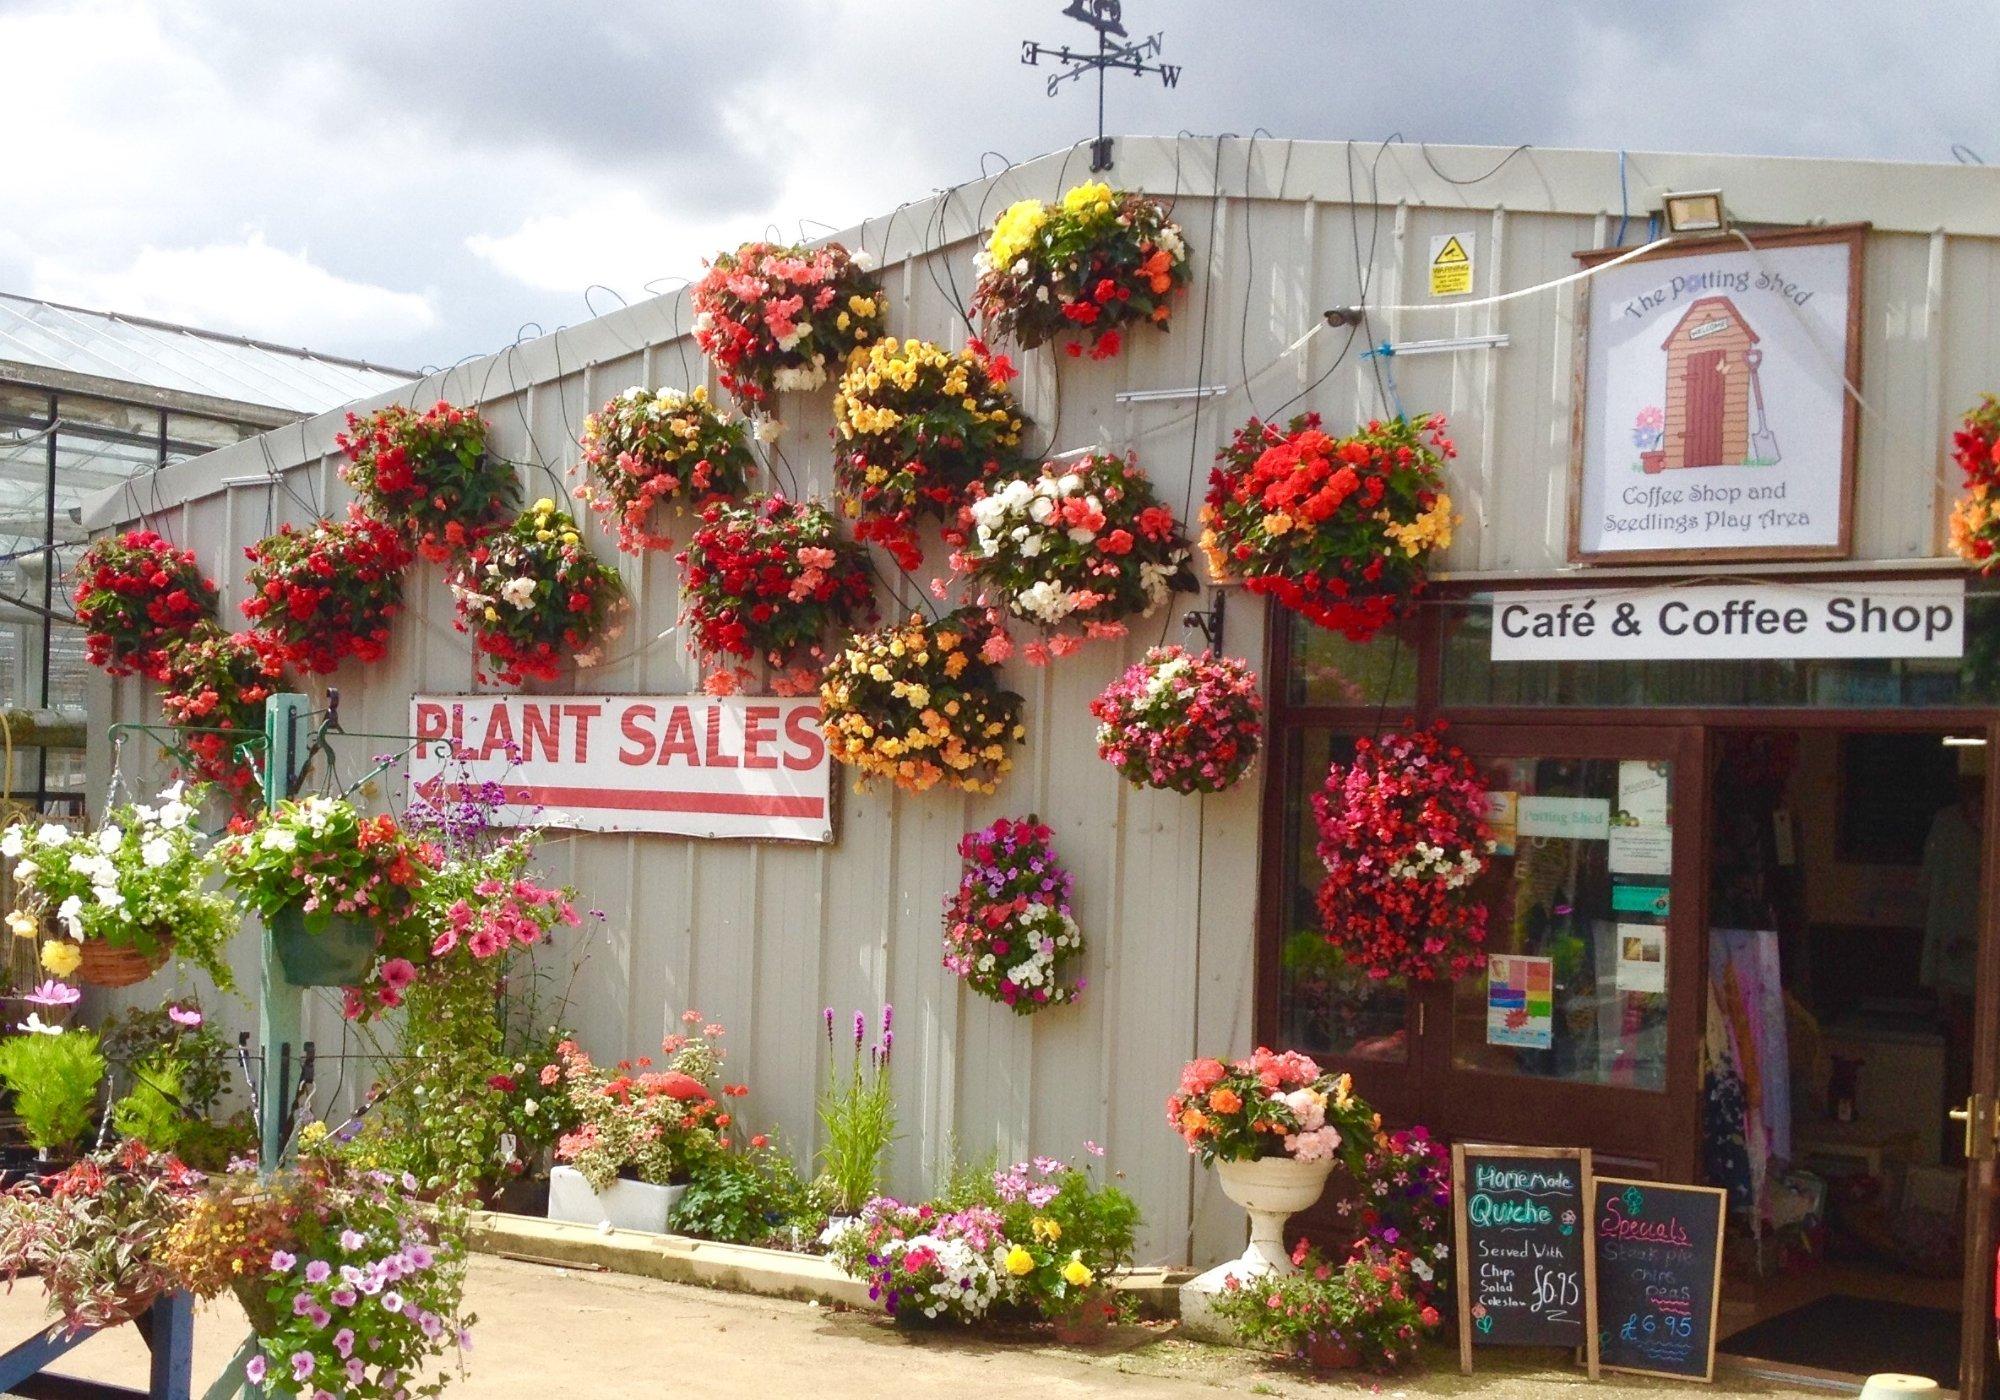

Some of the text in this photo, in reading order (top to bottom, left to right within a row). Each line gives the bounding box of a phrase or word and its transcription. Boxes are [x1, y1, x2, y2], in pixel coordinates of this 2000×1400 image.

[1159, 64, 1182, 89] W
[1625, 270, 1814, 319] The Potting Shed
[1622, 482, 1786, 507] Coffee Shop and
[1604, 509, 1810, 533] Seedlings Play Area
[1501, 598, 1953, 642] Café & Coffee Shop
[416, 703, 824, 770] PLANT SALES
[1470, 1194, 1552, 1227] Quiche
[1601, 1196, 1688, 1240] Specials
[1479, 1239, 1564, 1258] Served With
[1481, 1263, 1515, 1283] Chips
[1481, 1279, 1513, 1292] Salad
[1530, 1264, 1579, 1312] £6.95
